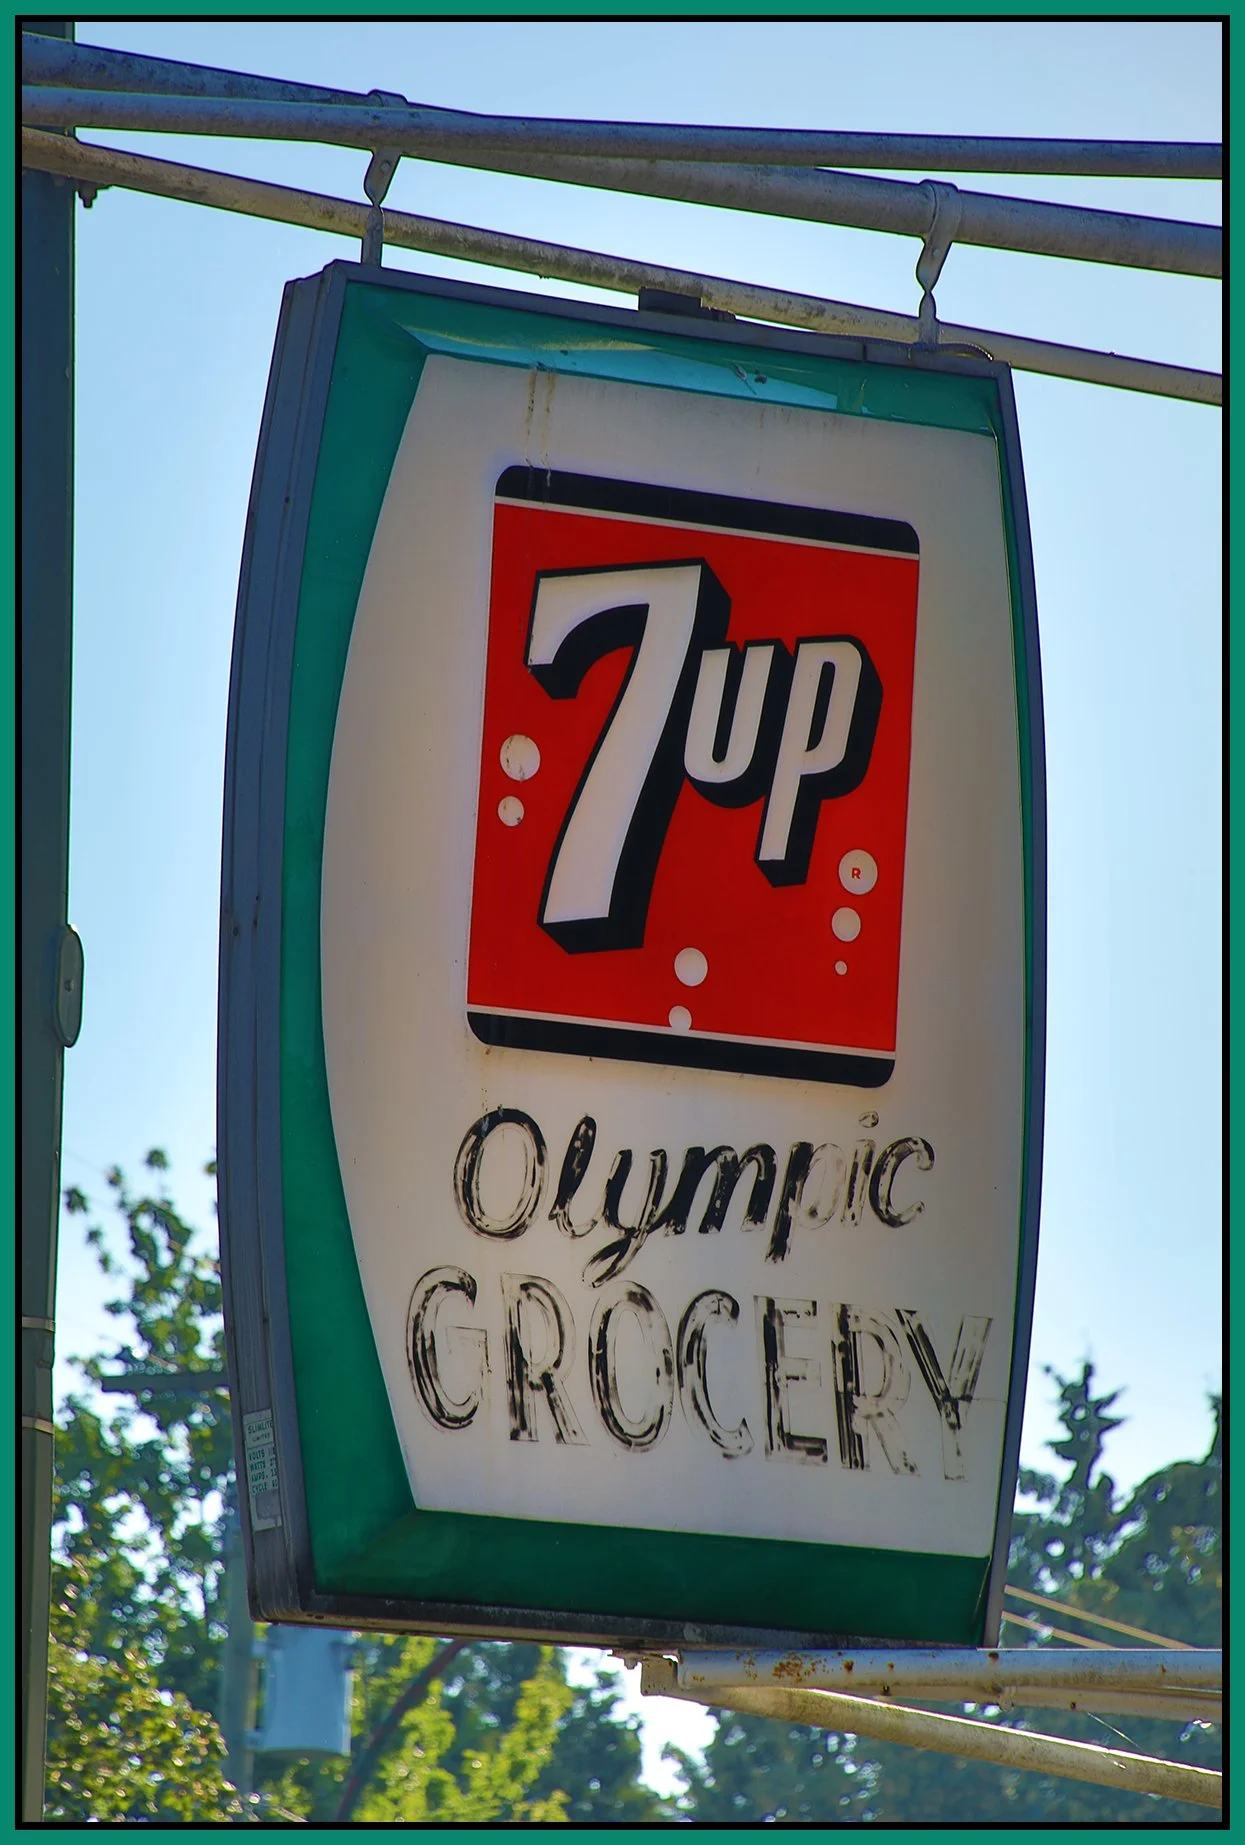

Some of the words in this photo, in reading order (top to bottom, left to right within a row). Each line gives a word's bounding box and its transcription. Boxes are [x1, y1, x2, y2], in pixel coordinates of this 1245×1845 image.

[452, 1107, 936, 1288] Olympic
[407, 1265, 993, 1482] GROCERY
[249, 1449, 265, 1460] VOLTS
[250, 1460, 266, 1472] WATTS
